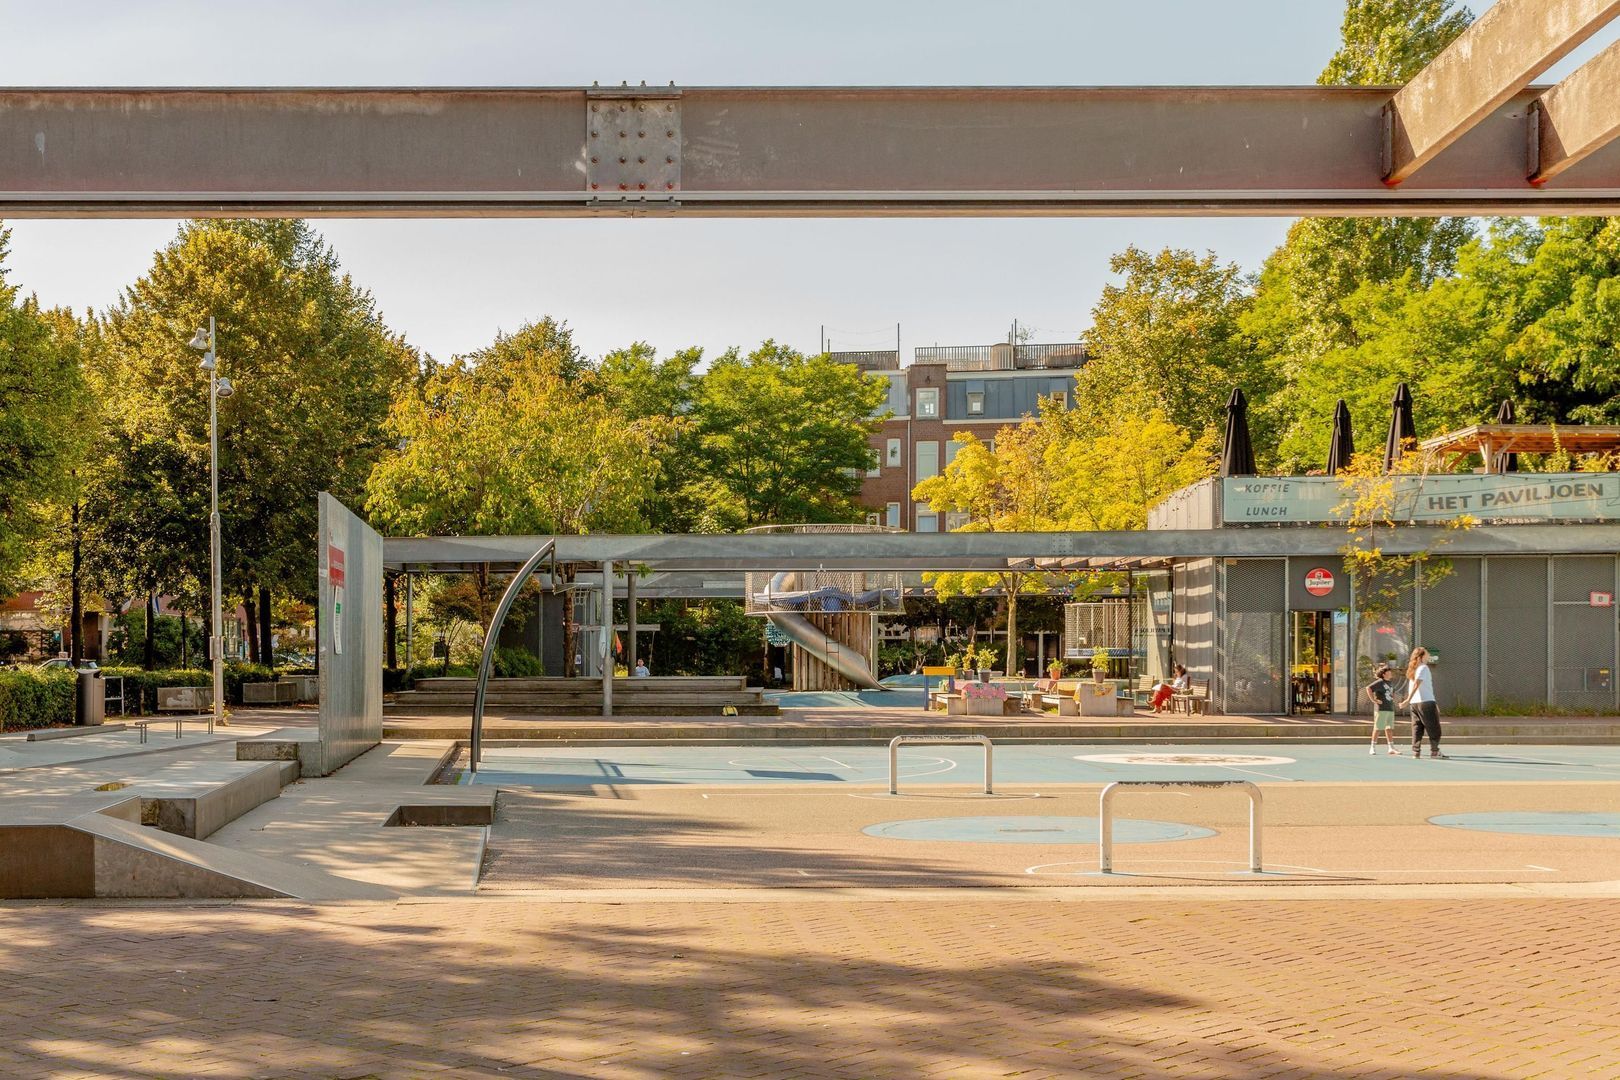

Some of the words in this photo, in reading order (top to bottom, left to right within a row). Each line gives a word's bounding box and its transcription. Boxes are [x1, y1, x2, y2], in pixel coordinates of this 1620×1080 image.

[1245, 484, 1290, 493] KOFFIE
[1428, 495, 1473, 510] HET
[1481, 483, 1604, 507] PAVILJOEN
[1246, 507, 1288, 516] LUNCH
